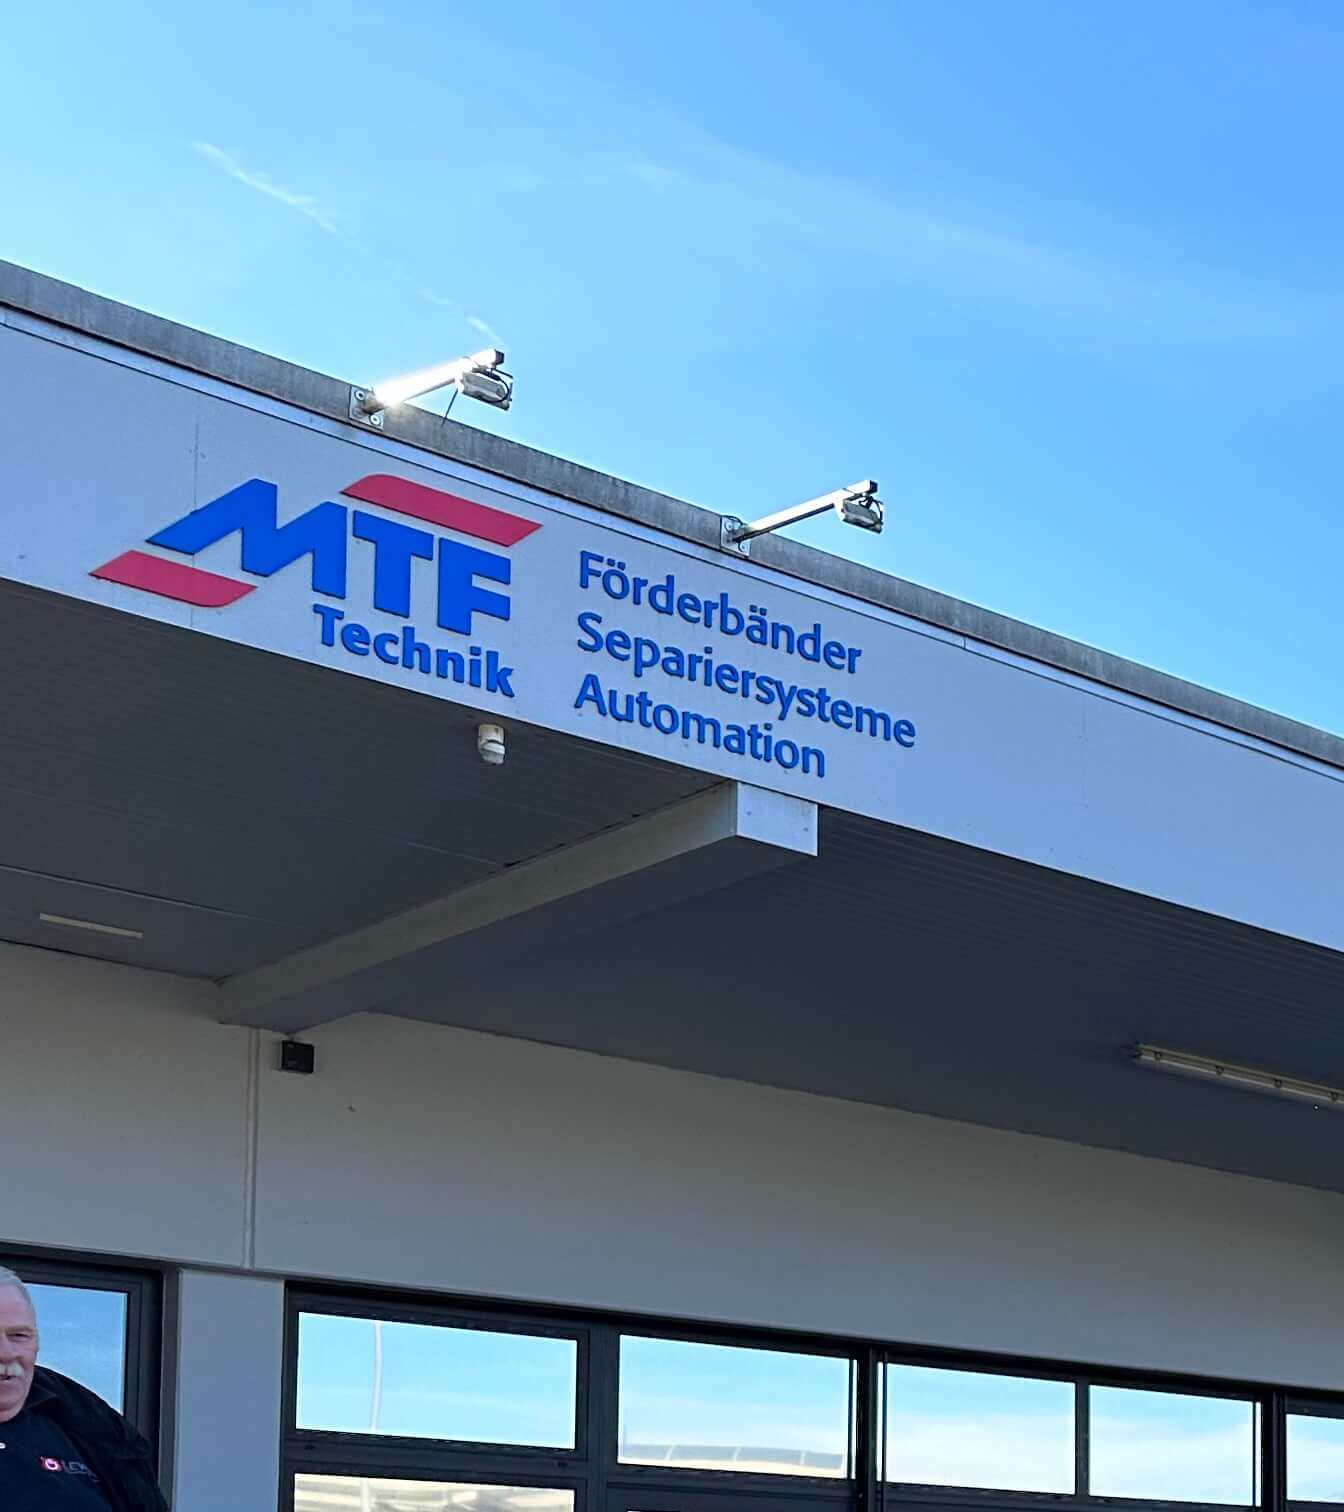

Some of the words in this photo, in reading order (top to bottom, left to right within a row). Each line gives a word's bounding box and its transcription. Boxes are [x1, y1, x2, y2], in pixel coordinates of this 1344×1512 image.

[146, 478, 512, 637] MTF
[578, 549, 863, 676] Förderbänder
[312, 602, 515, 698] Technik
[577, 611, 916, 749] Separiersysteme
[575, 673, 826, 779] Automation
